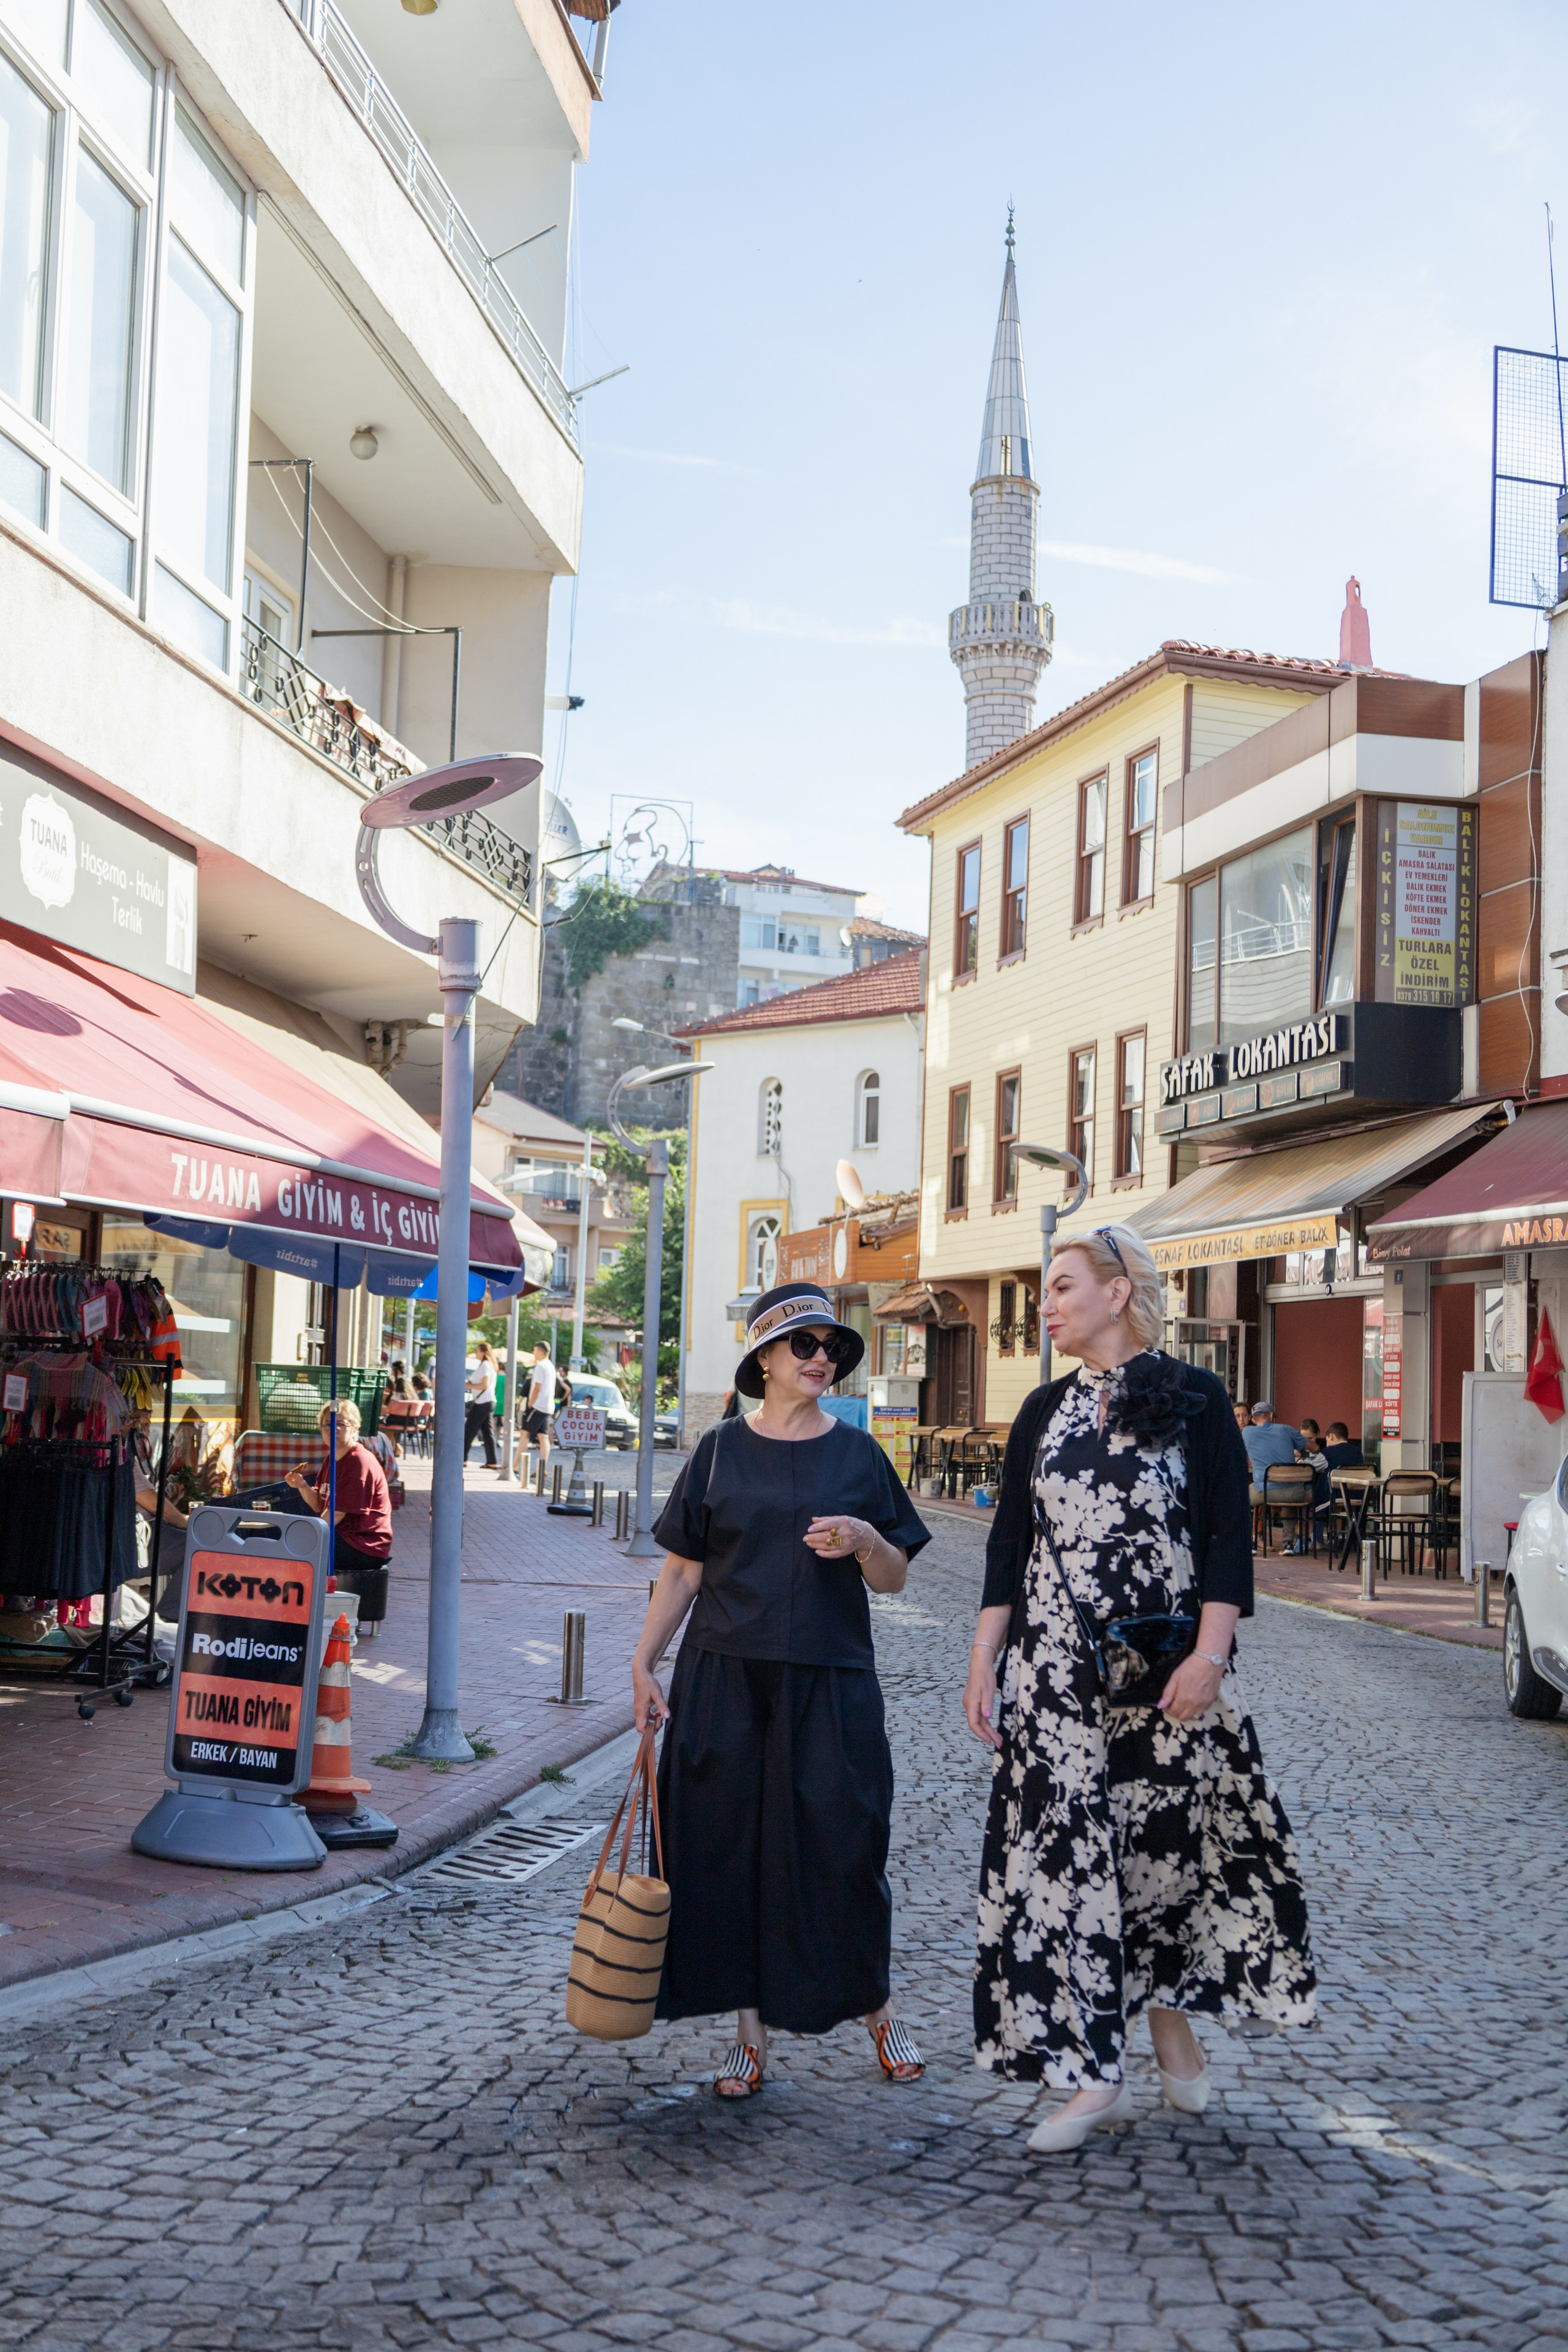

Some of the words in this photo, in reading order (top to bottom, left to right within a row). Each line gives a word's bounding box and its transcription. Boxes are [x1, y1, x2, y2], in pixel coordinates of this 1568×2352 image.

[1417, 808, 1437, 820] AİLE
[1400, 820, 1455, 834] SALONUMUZ
[31, 818, 67, 857] TUANA
[1410, 834, 1443, 845] VARDIR
[1418, 850, 1436, 859] BALIK
[1398, 859, 1425, 869] AMASRA
[1426, 862, 1455, 872] SALATASI
[80, 841, 127, 889] Haşema
[136, 870, 164, 907] Havlu
[1414, 873, 1448, 882] YEMEKLERİ
[1406, 883, 1424, 891] BALIK
[1406, 892, 1424, 902] KÖFTE
[1426, 895, 1447, 905] EKMEK
[111, 895, 142, 935] Terlik
[1404, 903, 1425, 913] DÖNER
[1427, 906, 1447, 915] EKMEK
[1411, 914, 1441, 926] İSKENDER
[1411, 927, 1440, 937] KAHVALTI
[1398, 940, 1452, 955] TURLARA
[1411, 956, 1439, 971] ÖZEL
[1400, 971, 1449, 988] İNDİRİM
[1397, 991, 1411, 1000] 0378
[1413, 990, 1428, 1002] 315
[1431, 992, 1439, 1003] 19
[1443, 992, 1452, 1004] 17
[1229, 1014, 1336, 1080] LOKANTASI
[172, 1153, 261, 1212] TUANA
[277, 1173, 343, 1227] GİYİM
[350, 1194, 365, 1231] &
[372, 1191, 393, 1246] İÇ
[399, 1201, 439, 1245] GİYİ
[1155, 1245, 1183, 1265] ESNAF
[1188, 1236, 1243, 1260] LOKANTASI
[1392, 1245, 1411, 1257] Polat
[567, 1410, 598, 1420] BEBE
[562, 1420, 602, 1431] ÇOCUK
[186, 1691, 239, 1725] TUANA
[243, 1694, 292, 1732] GİYİM
[190, 1741, 228, 1763] ERKEK
[229, 1747, 238, 1763] /
[239, 1747, 277, 1769] BAYAN
